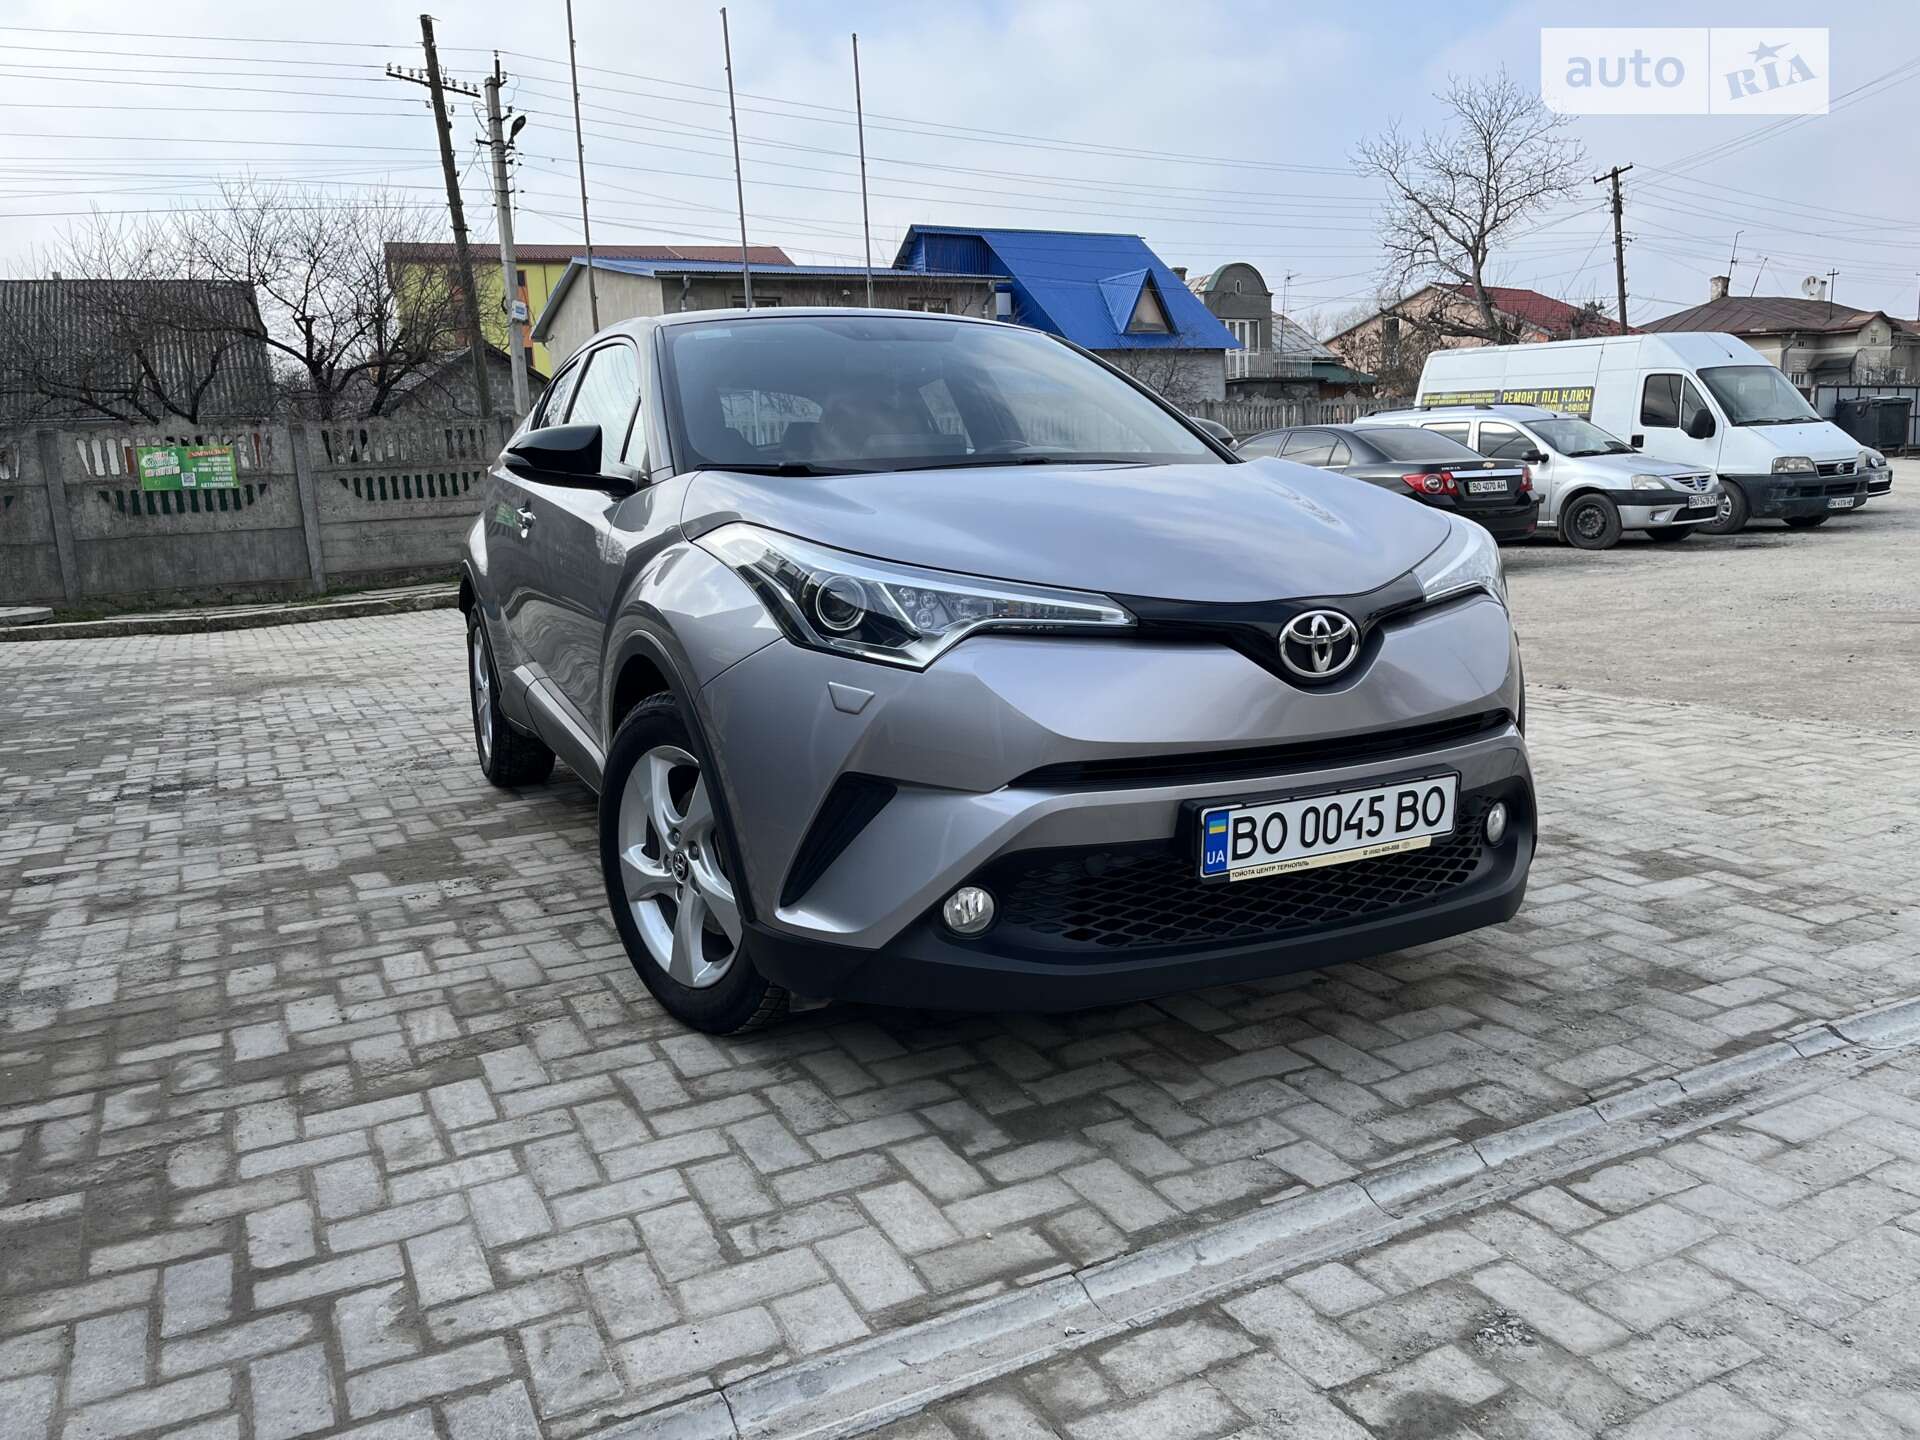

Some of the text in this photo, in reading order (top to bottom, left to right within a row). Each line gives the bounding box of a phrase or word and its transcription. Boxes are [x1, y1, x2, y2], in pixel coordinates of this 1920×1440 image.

[1503, 391, 1539, 404] РЕМОНТ
[1541, 390, 1558, 404] ПІД
[1562, 389, 1592, 402] КЛЮЧ
[1472, 481, 1482, 491] BO
[1231, 786, 1446, 861] BO 0045 BO
[1206, 850, 1225, 865] UA
[1231, 869, 1256, 879] ТОЙОТА
[1256, 865, 1277, 875] ЦЕНТР
